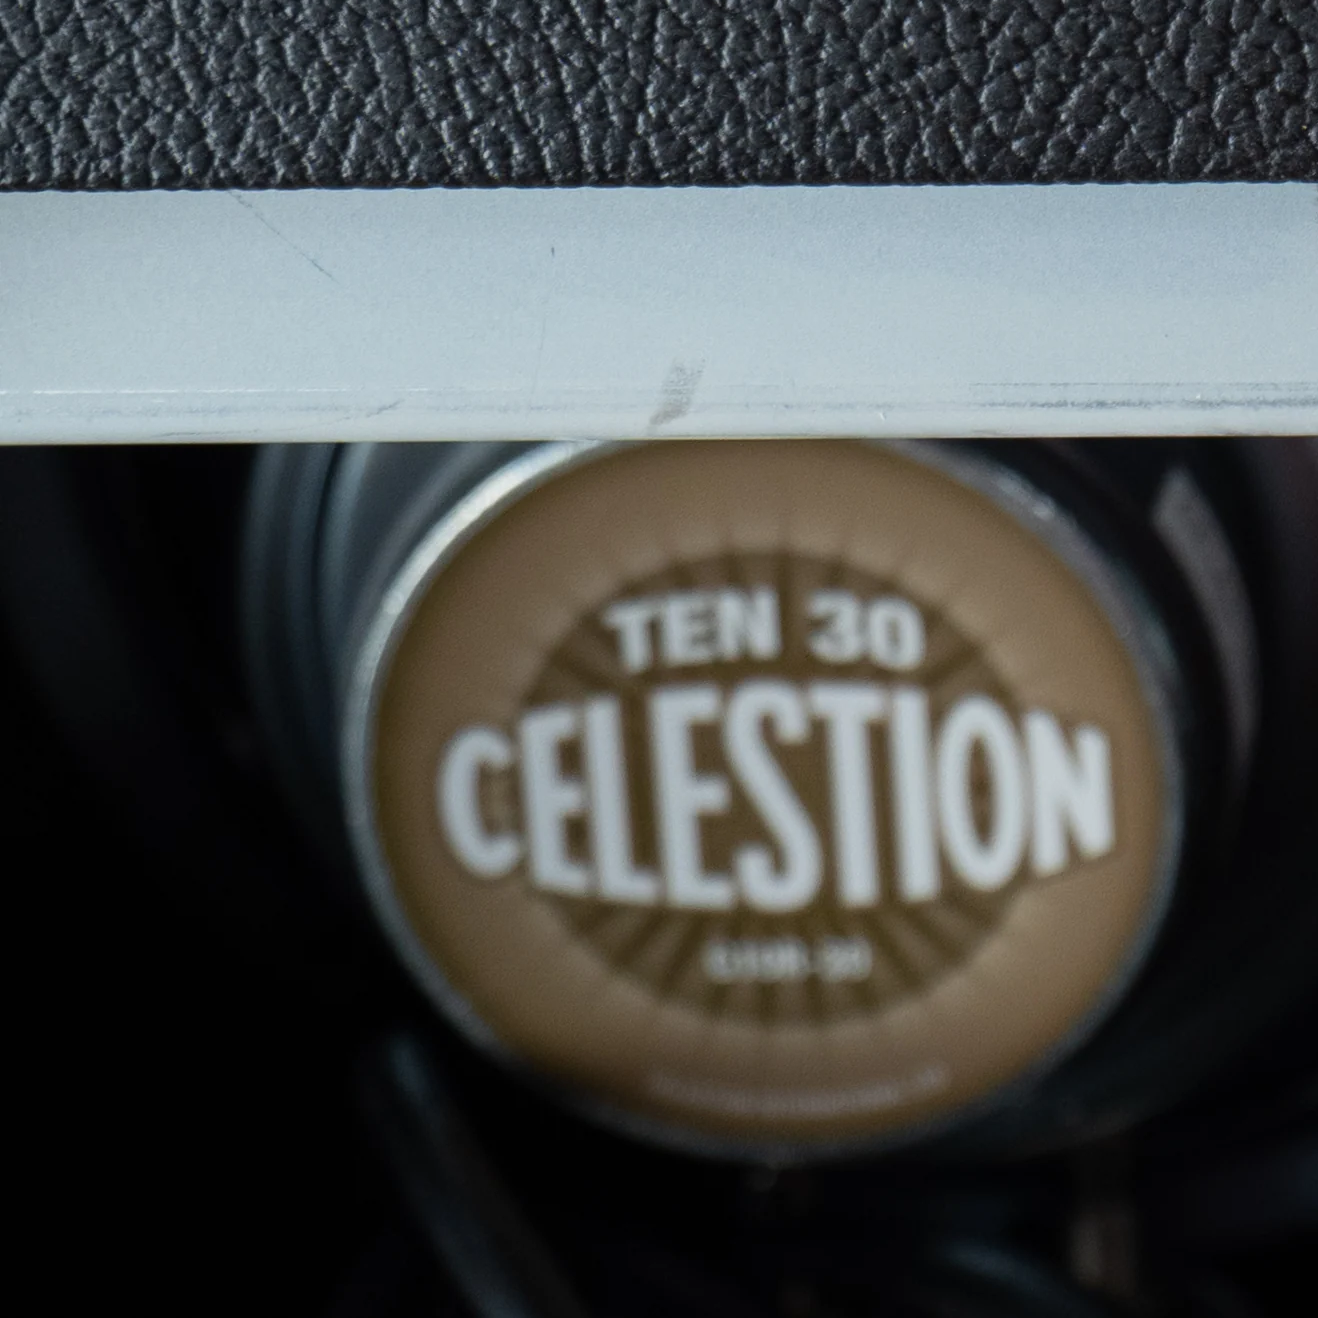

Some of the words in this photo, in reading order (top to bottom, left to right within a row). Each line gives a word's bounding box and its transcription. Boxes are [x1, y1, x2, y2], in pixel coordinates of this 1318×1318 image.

[605, 585, 782, 673] TEN
[807, 589, 927, 670] 30
[440, 678, 1116, 911] CELESTION
